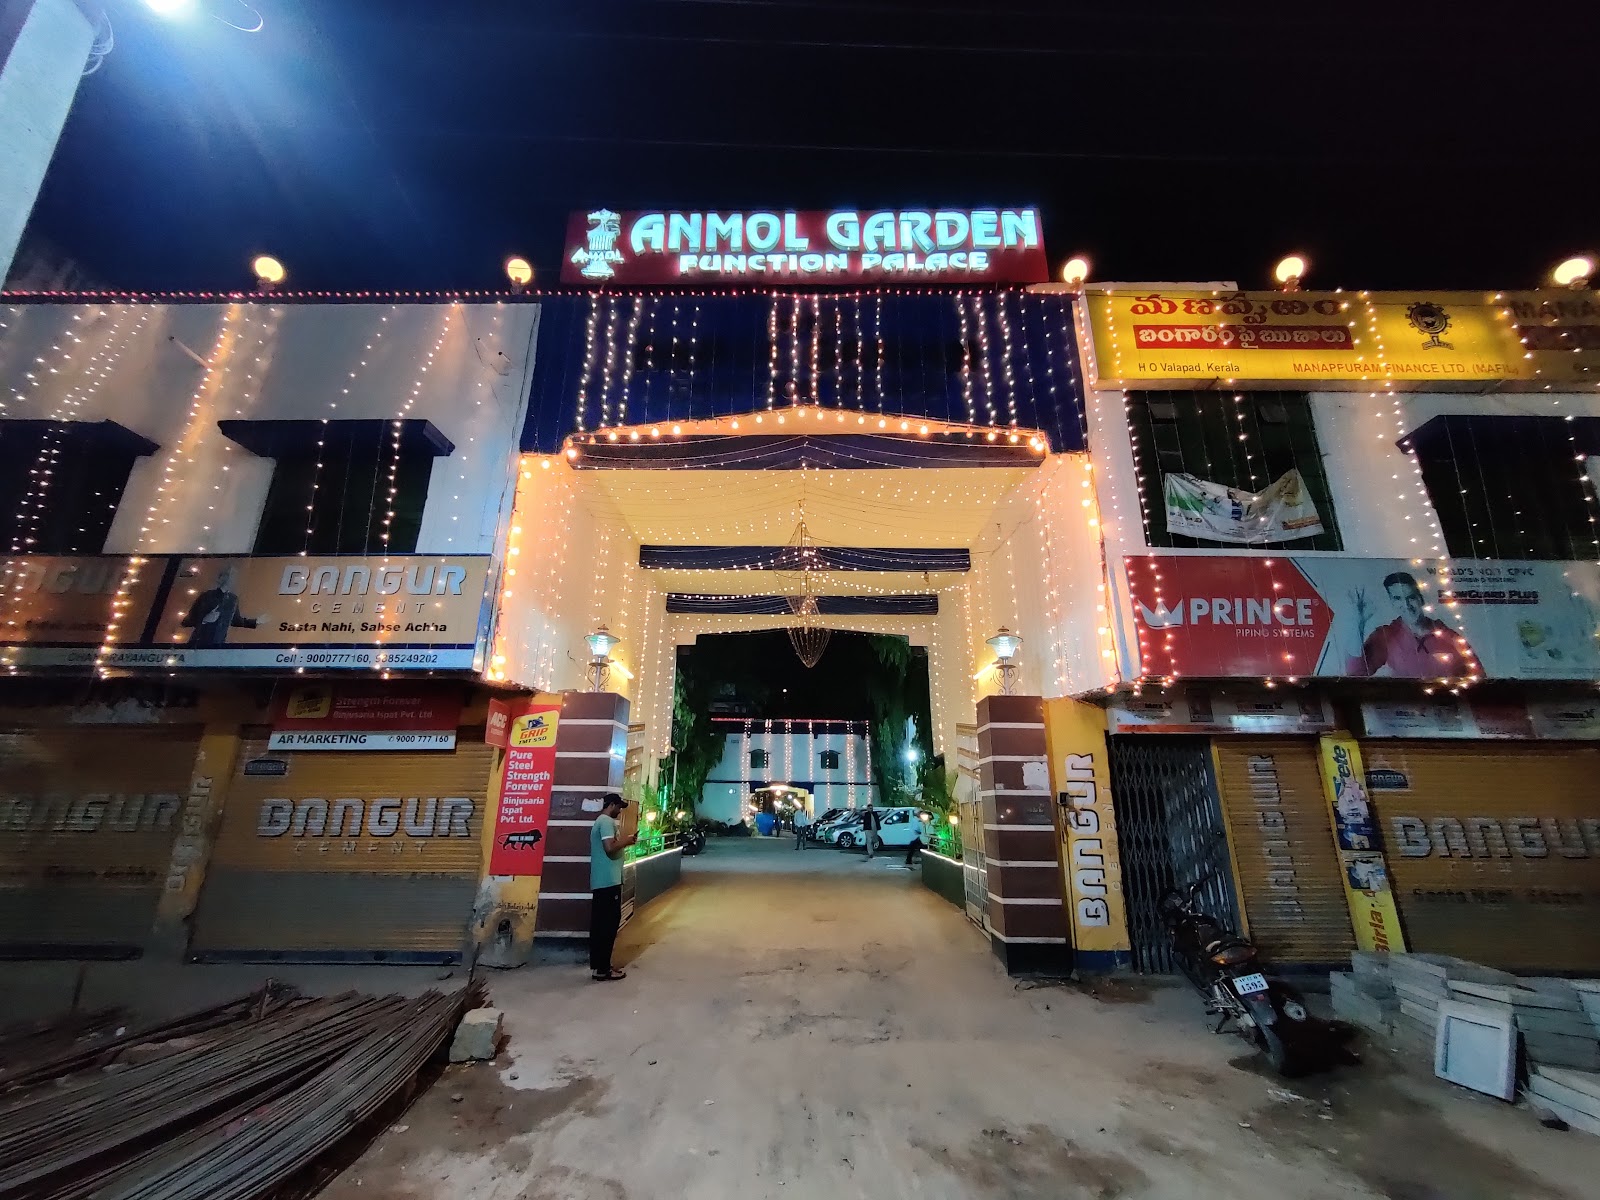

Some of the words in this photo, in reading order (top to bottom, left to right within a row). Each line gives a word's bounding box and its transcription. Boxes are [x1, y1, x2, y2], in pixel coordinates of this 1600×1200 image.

[630, 212, 809, 256] ANMOL
[826, 210, 1038, 256] GARDEN
[571, 247, 625, 265] ANMOL
[679, 253, 848, 275] FUNCTION
[861, 251, 990, 273] PALACE
[1138, 363, 1146, 372] H
[1149, 363, 1158, 372] O
[1207, 362, 1240, 372] Kerala
[1293, 363, 1381, 373] MANAPPURAM
[1385, 363, 1441, 373] FINANCE
[1443, 363, 1469, 373] LTD.
[1426, 567, 1474, 576] WOLD'S
[278, 565, 467, 596] BANGUR
[311, 602, 425, 614] CEMENT
[1190, 597, 1314, 626] PRINCE
[279, 622, 317, 632] Sasta
[321, 622, 355, 633] Nahi,
[360, 622, 400, 632] Sabse
[1236, 629, 1269, 637] PIPING
[1272, 629, 1315, 638] SYSTEMS
[276, 654, 296, 663] Cell
[490, 711, 507, 729] ACC
[520, 727, 548, 740] GRIP
[278, 735, 295, 744] AR
[297, 735, 367, 744] MARKETING
[396, 735, 415, 743] 9000
[417, 735, 432, 743] 777
[434, 735, 449, 743] 160
[509, 750, 533, 760] Pure
[508, 761, 534, 769] Steel
[507, 771, 550, 782] Strength
[505, 782, 543, 790] Forever
[503, 797, 544, 806] Binjusaria
[502, 807, 523, 815] Ispat
[256, 797, 475, 837] BANGUR
[519, 815, 534, 823] Ltd.
[1065, 753, 1110, 927] BANGUR
